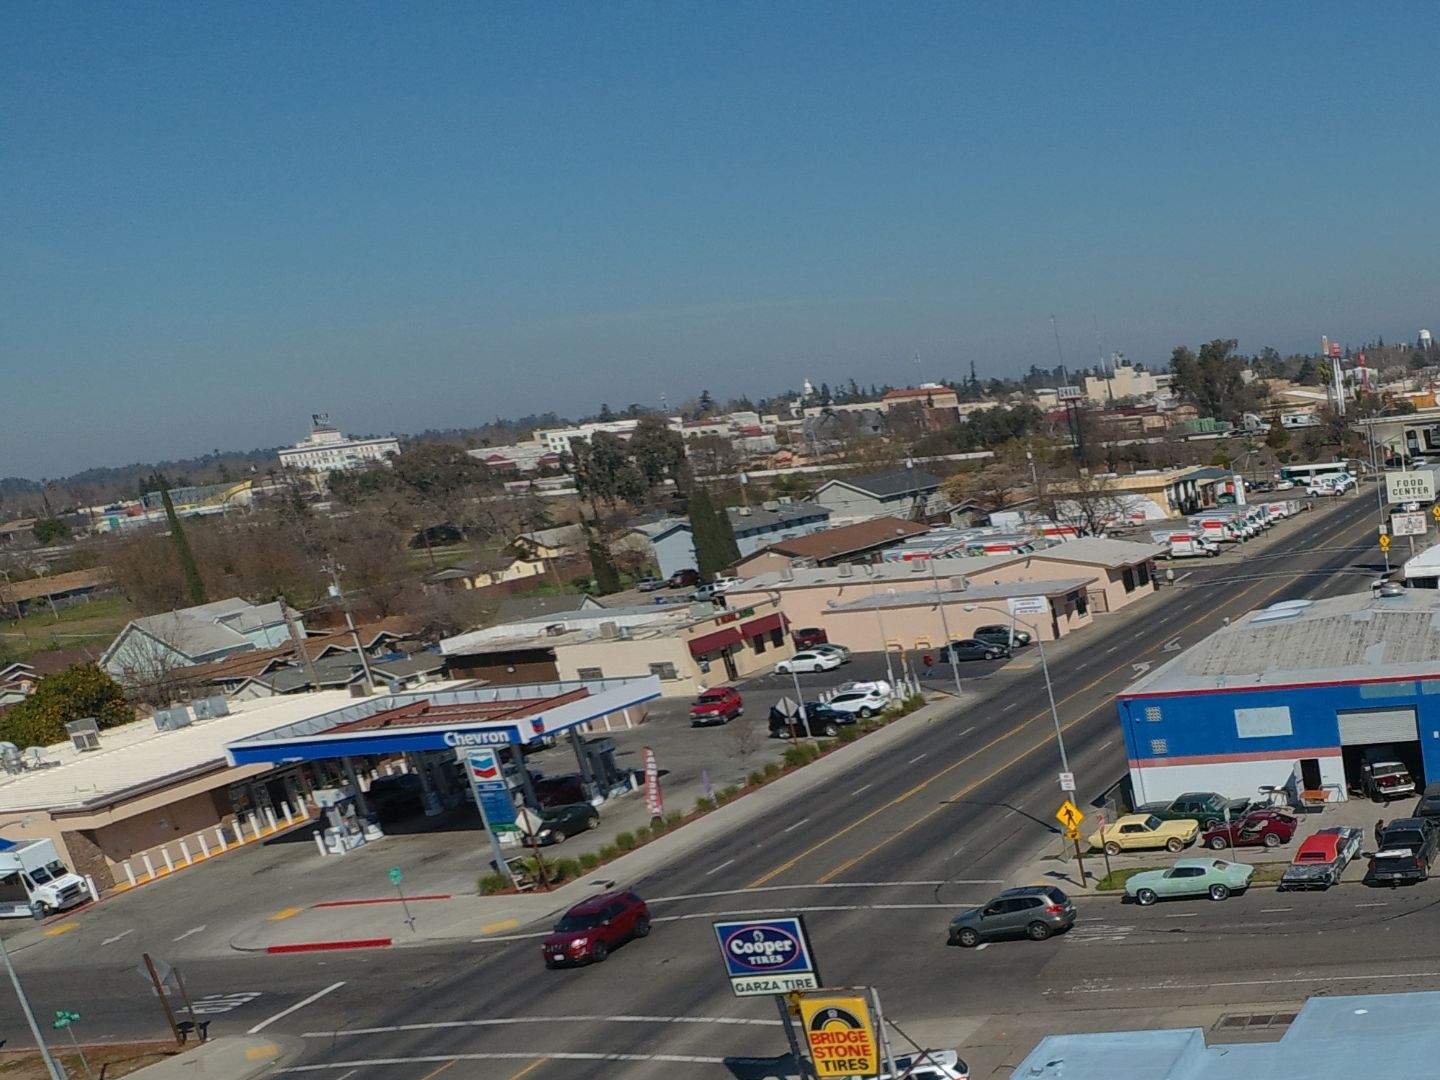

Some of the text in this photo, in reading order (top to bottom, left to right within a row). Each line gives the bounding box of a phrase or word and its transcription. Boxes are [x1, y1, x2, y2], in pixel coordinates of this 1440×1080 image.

[1396, 479, 1424, 487] FOOD
[1392, 487, 1429, 496] CENTER
[443, 731, 510, 747] Chevron
[730, 939, 793, 956] Cooper
[748, 954, 785, 965] TIRES
[735, 978, 814, 993] GARZA TIRE
[809, 1030, 869, 1045] BRIDGE
[813, 1044, 872, 1059] STONE
[821, 1058, 869, 1072] TIRES
